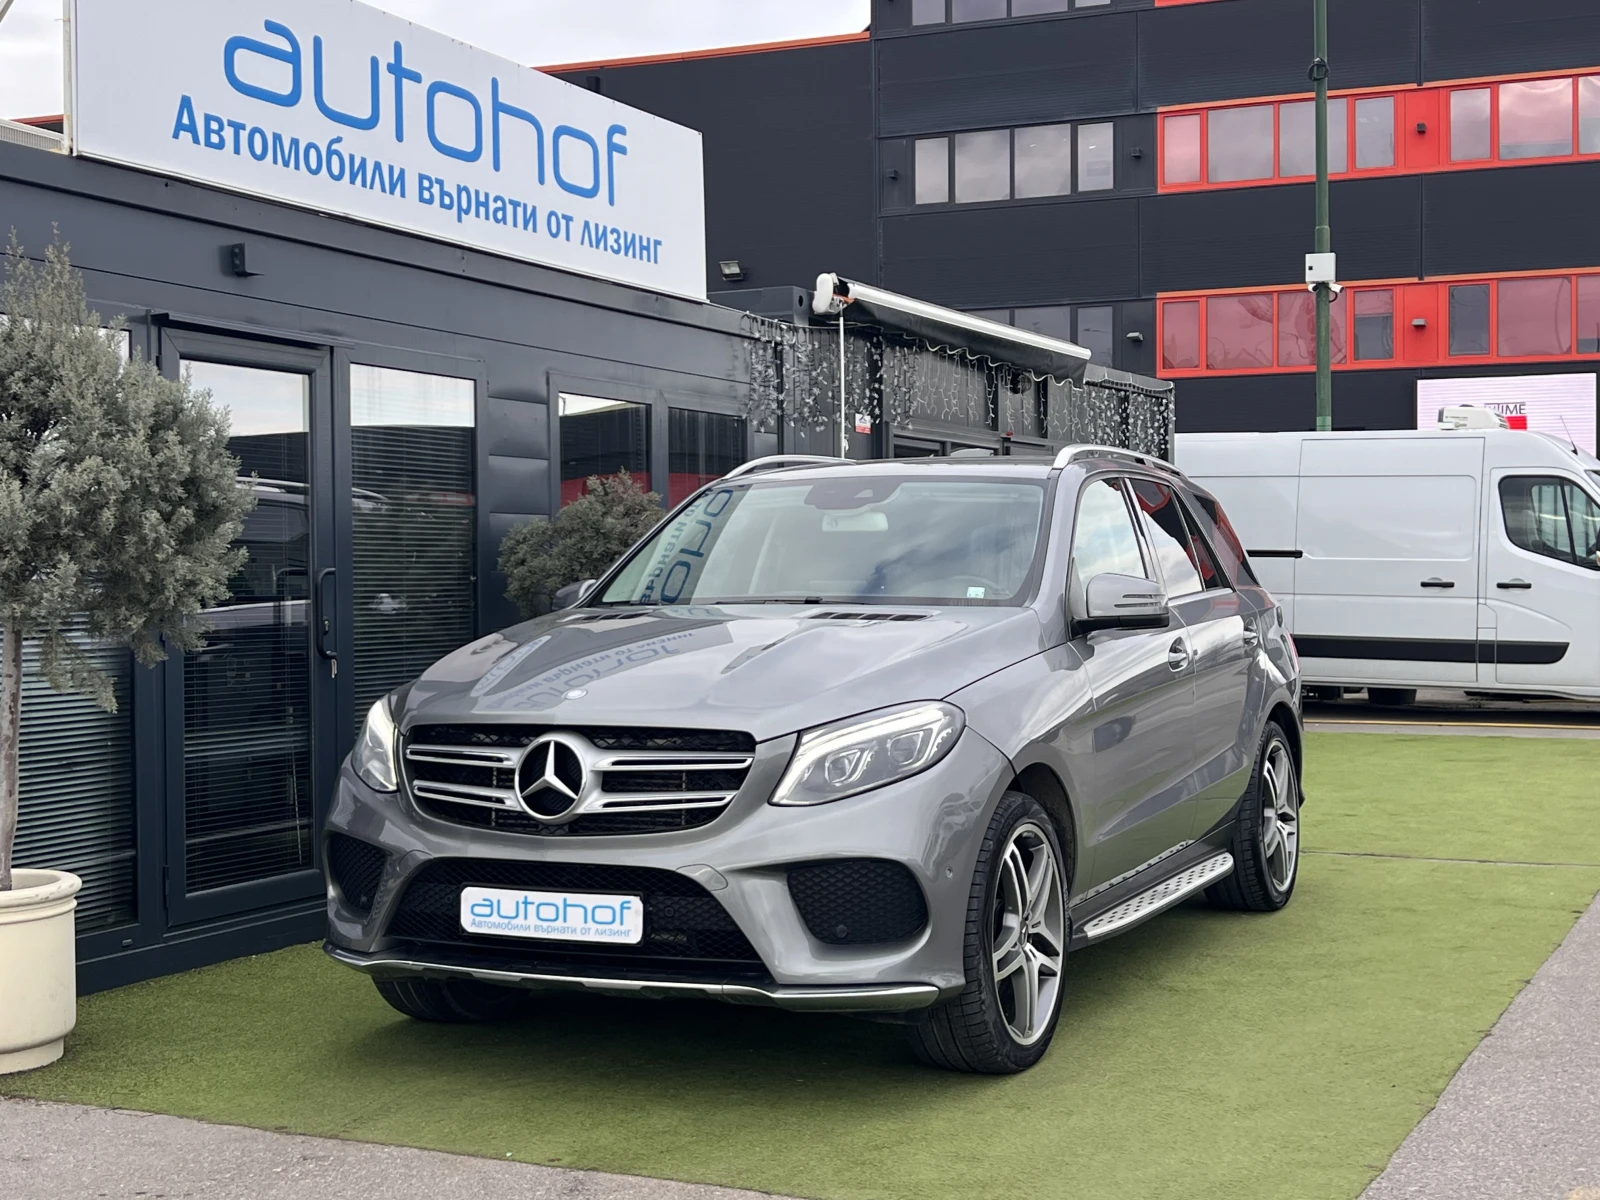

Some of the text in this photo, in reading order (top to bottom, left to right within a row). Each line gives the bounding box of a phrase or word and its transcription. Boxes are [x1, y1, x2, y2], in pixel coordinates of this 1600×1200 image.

[224, 20, 627, 205] autohof
[172, 95, 662, 263] Автомобили върнати от лизинг
[1484, 402, 1526, 415] TIME
[470, 895, 632, 926] autohof
[470, 918, 631, 937] Автомобили върнати от лизинг
